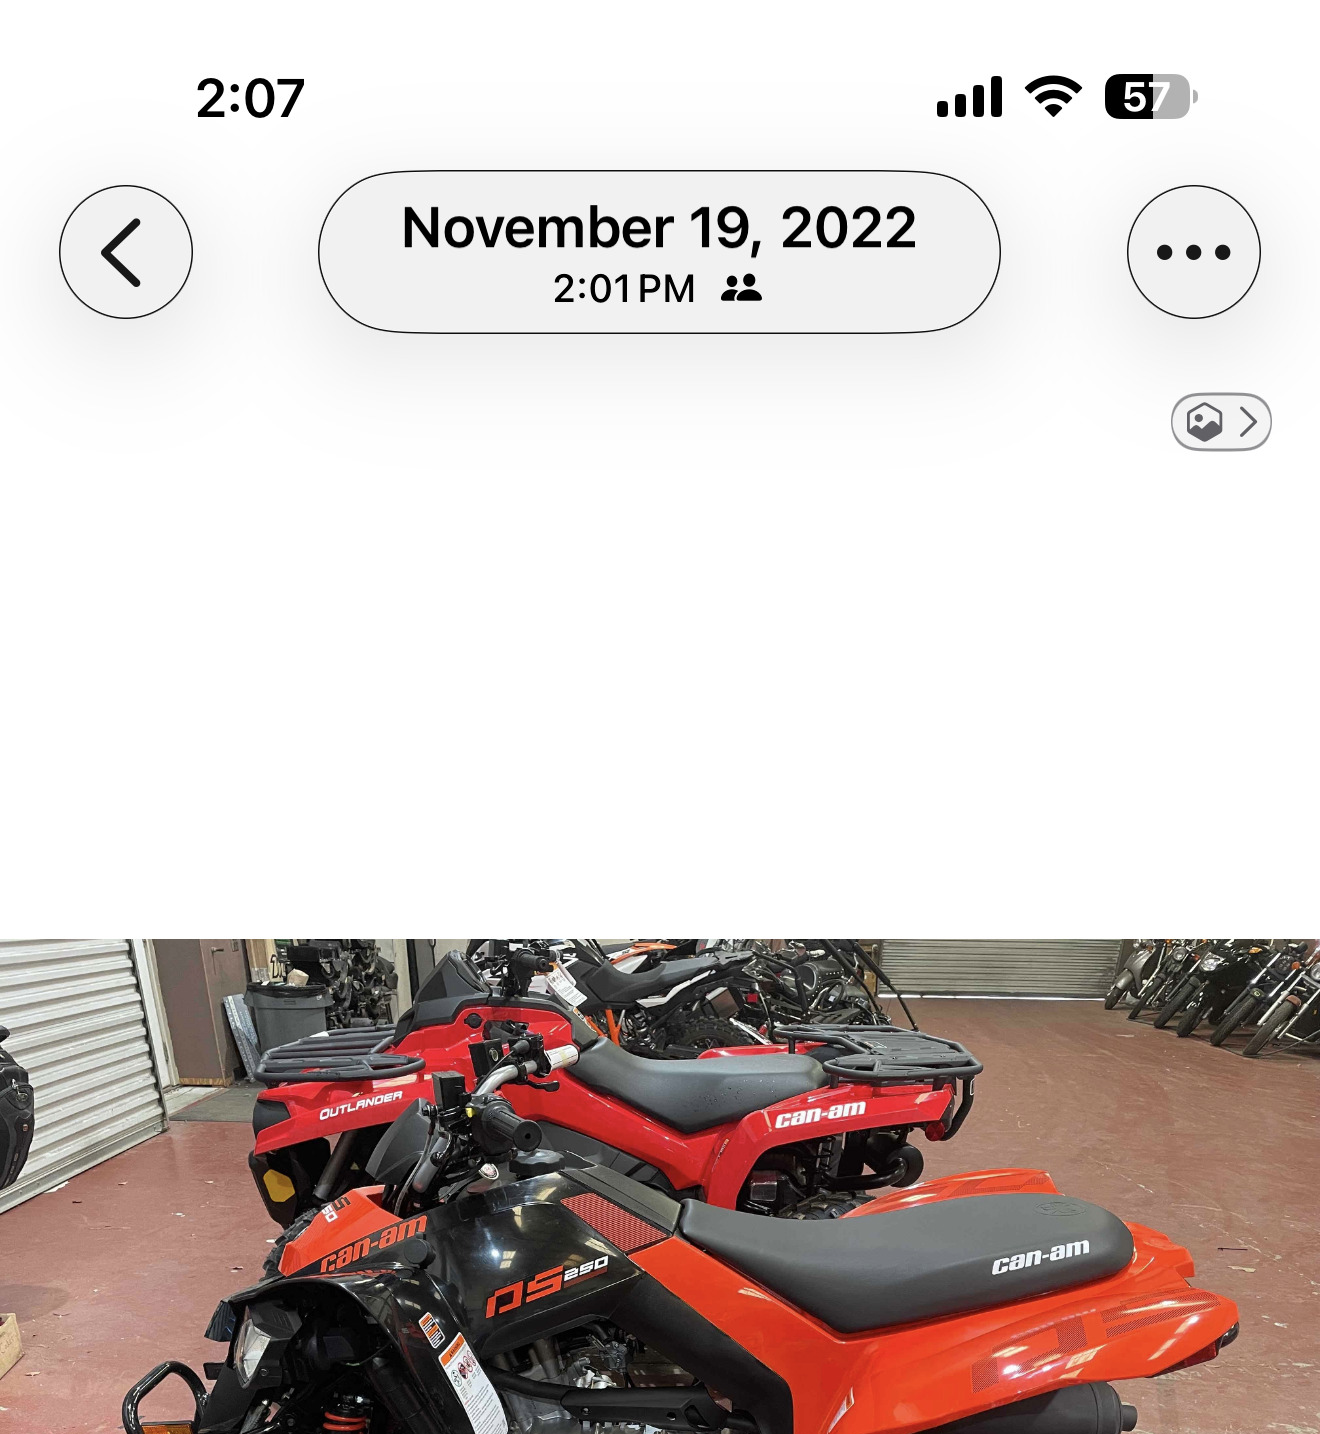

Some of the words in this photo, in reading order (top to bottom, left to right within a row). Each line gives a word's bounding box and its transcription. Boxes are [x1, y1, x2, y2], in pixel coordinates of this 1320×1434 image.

[319, 1090, 403, 1121] OUTLANDER
[774, 1101, 867, 1129] can-am
[319, 1214, 428, 1273] can-am
[991, 1239, 1090, 1276] can-am
[485, 1265, 564, 1319] DS
[563, 1255, 609, 1282] 250
